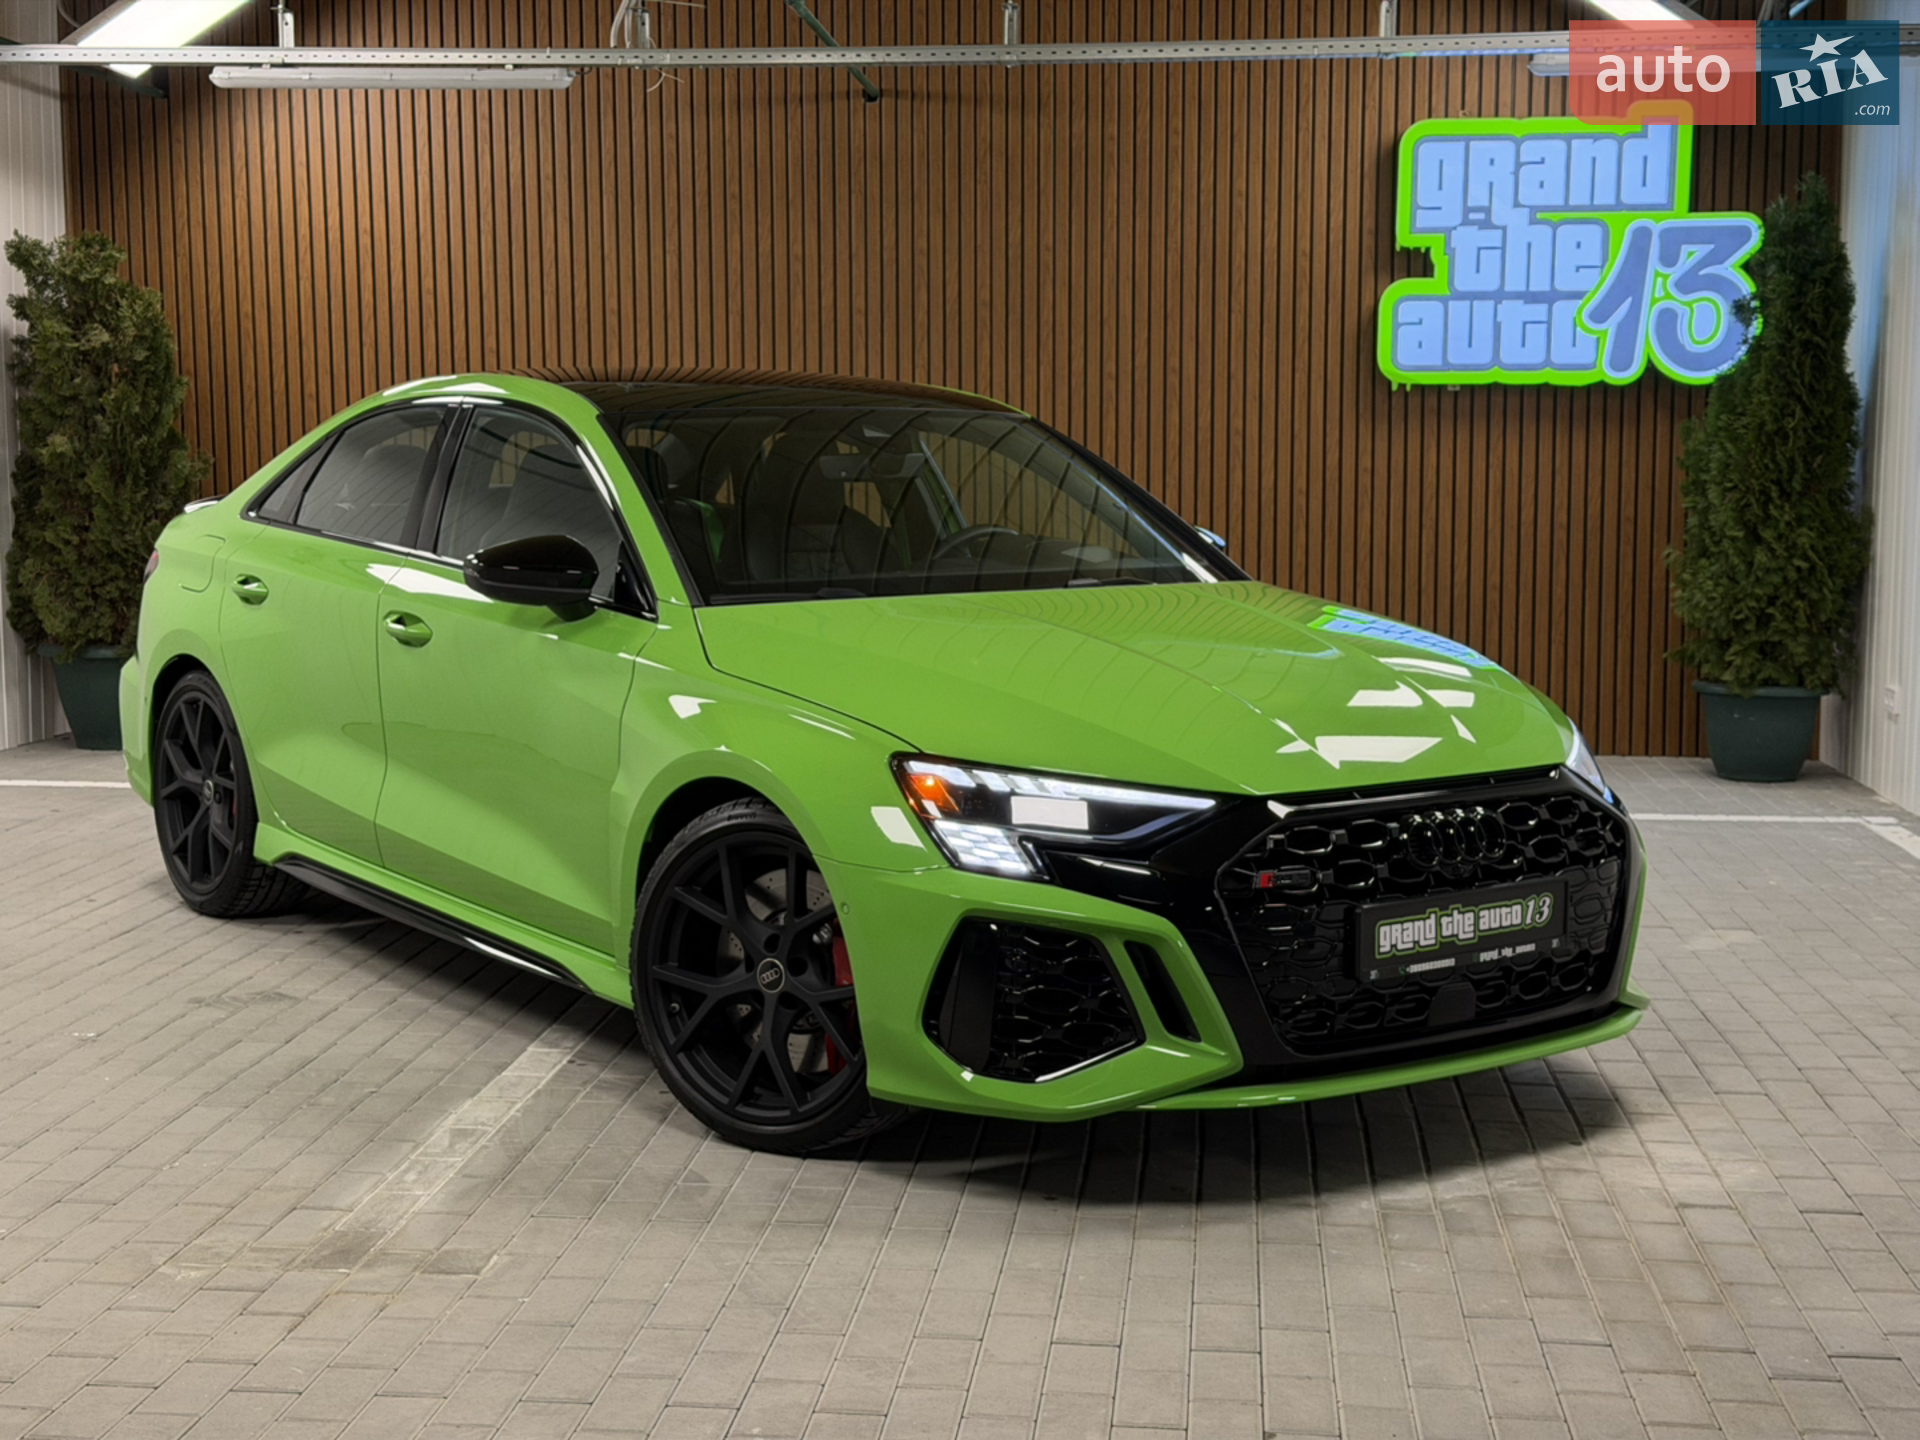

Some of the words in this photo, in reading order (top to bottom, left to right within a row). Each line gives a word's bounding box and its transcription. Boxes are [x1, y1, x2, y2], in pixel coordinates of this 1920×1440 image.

[1451, 207, 1603, 292] the
[1441, 910, 1475, 940] the
[1479, 905, 1522, 931] auto
[1523, 896, 1550, 925] 13
